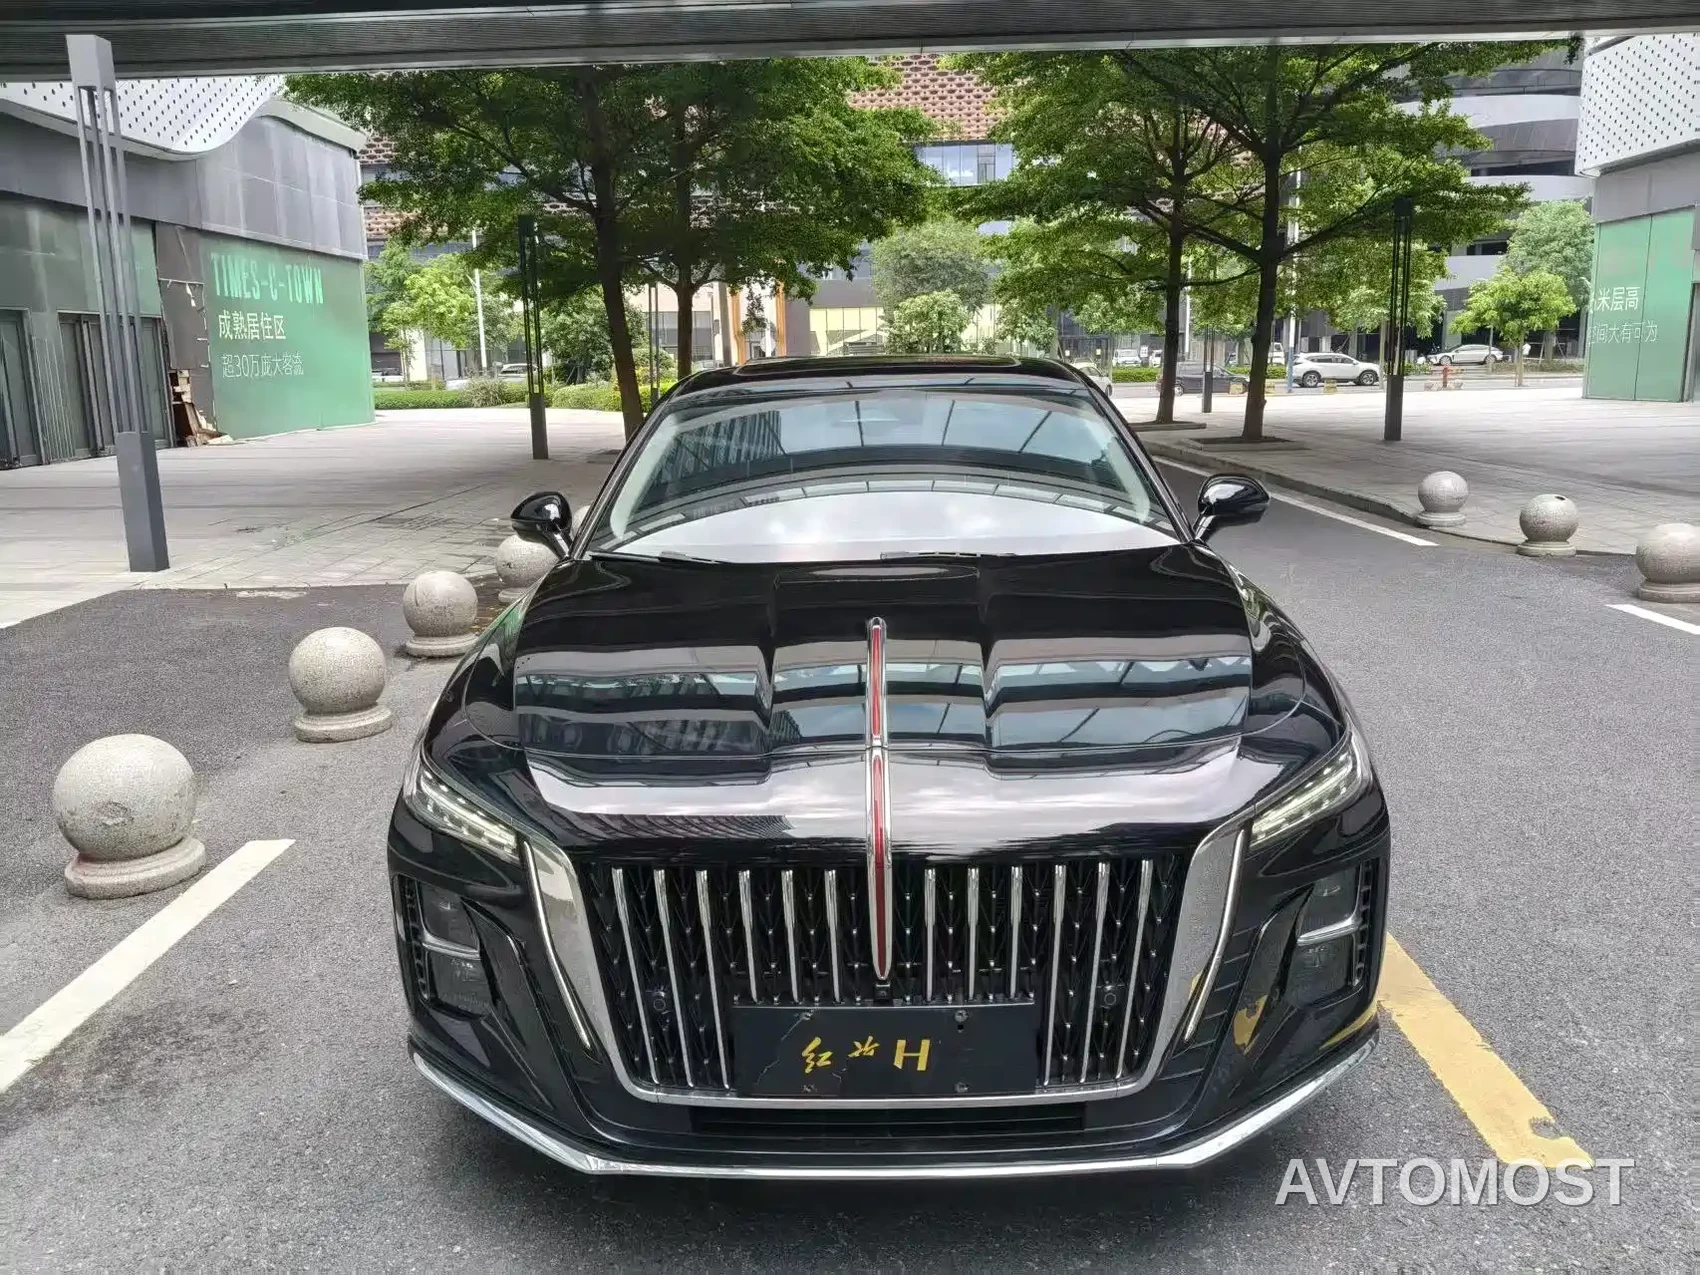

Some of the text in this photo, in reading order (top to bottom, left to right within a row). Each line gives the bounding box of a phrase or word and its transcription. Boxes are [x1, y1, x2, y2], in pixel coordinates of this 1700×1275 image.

[1589, 286, 1641, 313] 米层高
[218, 309, 287, 340] 成熟居住区
[222, 351, 304, 378] 超30万庞大客流
